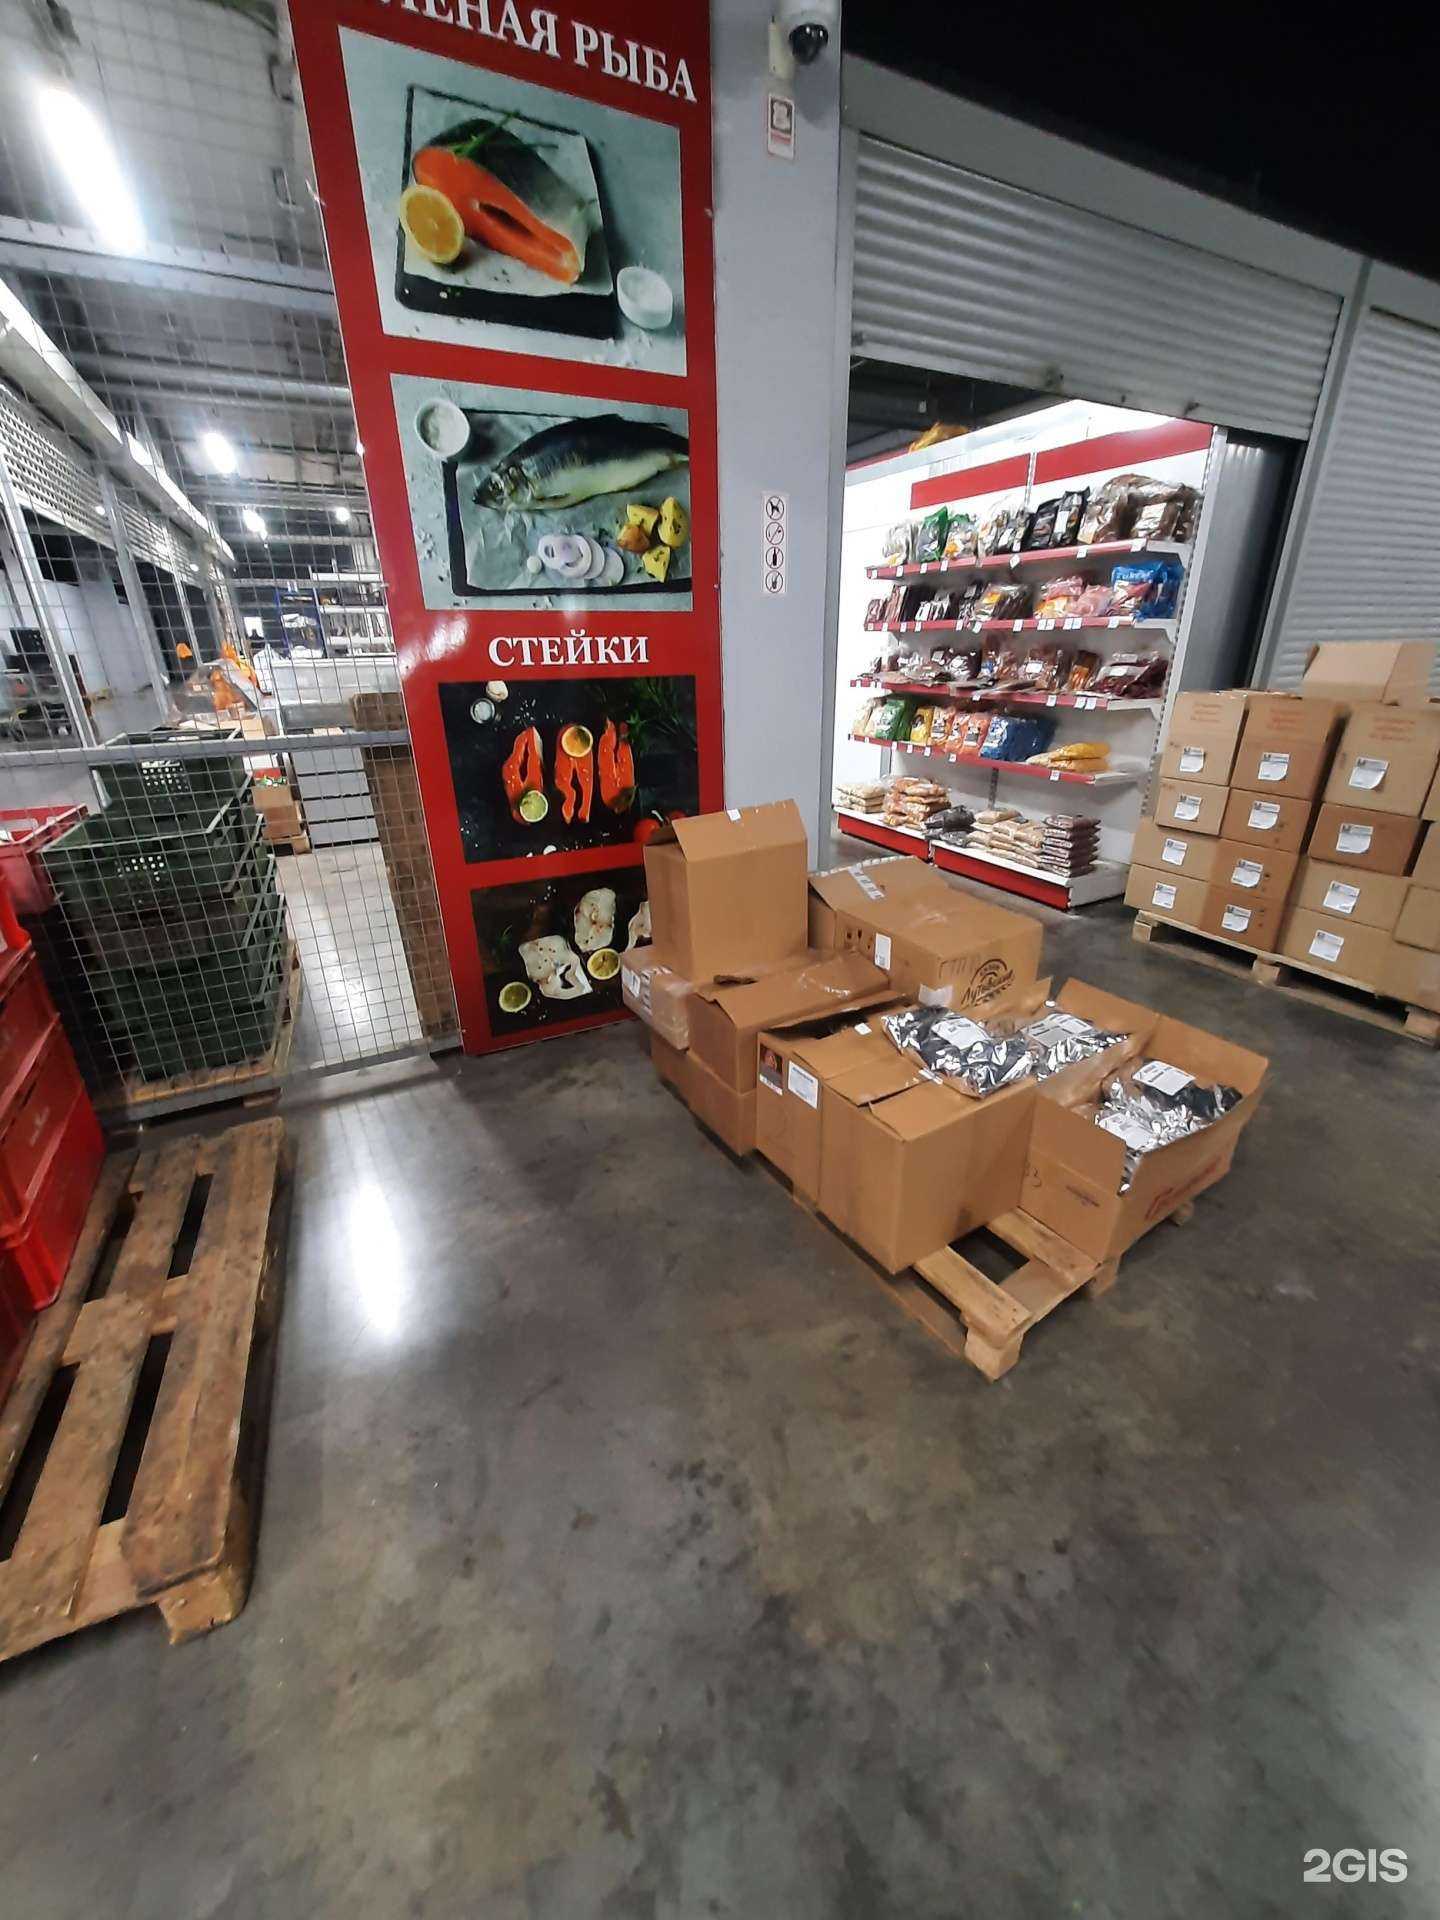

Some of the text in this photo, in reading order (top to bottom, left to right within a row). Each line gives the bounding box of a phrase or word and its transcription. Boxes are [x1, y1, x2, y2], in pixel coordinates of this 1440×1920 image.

[379, 0, 697, 103] ЕНАЯ РЫБА
[488, 629, 649, 667] СТЕЙКИ
